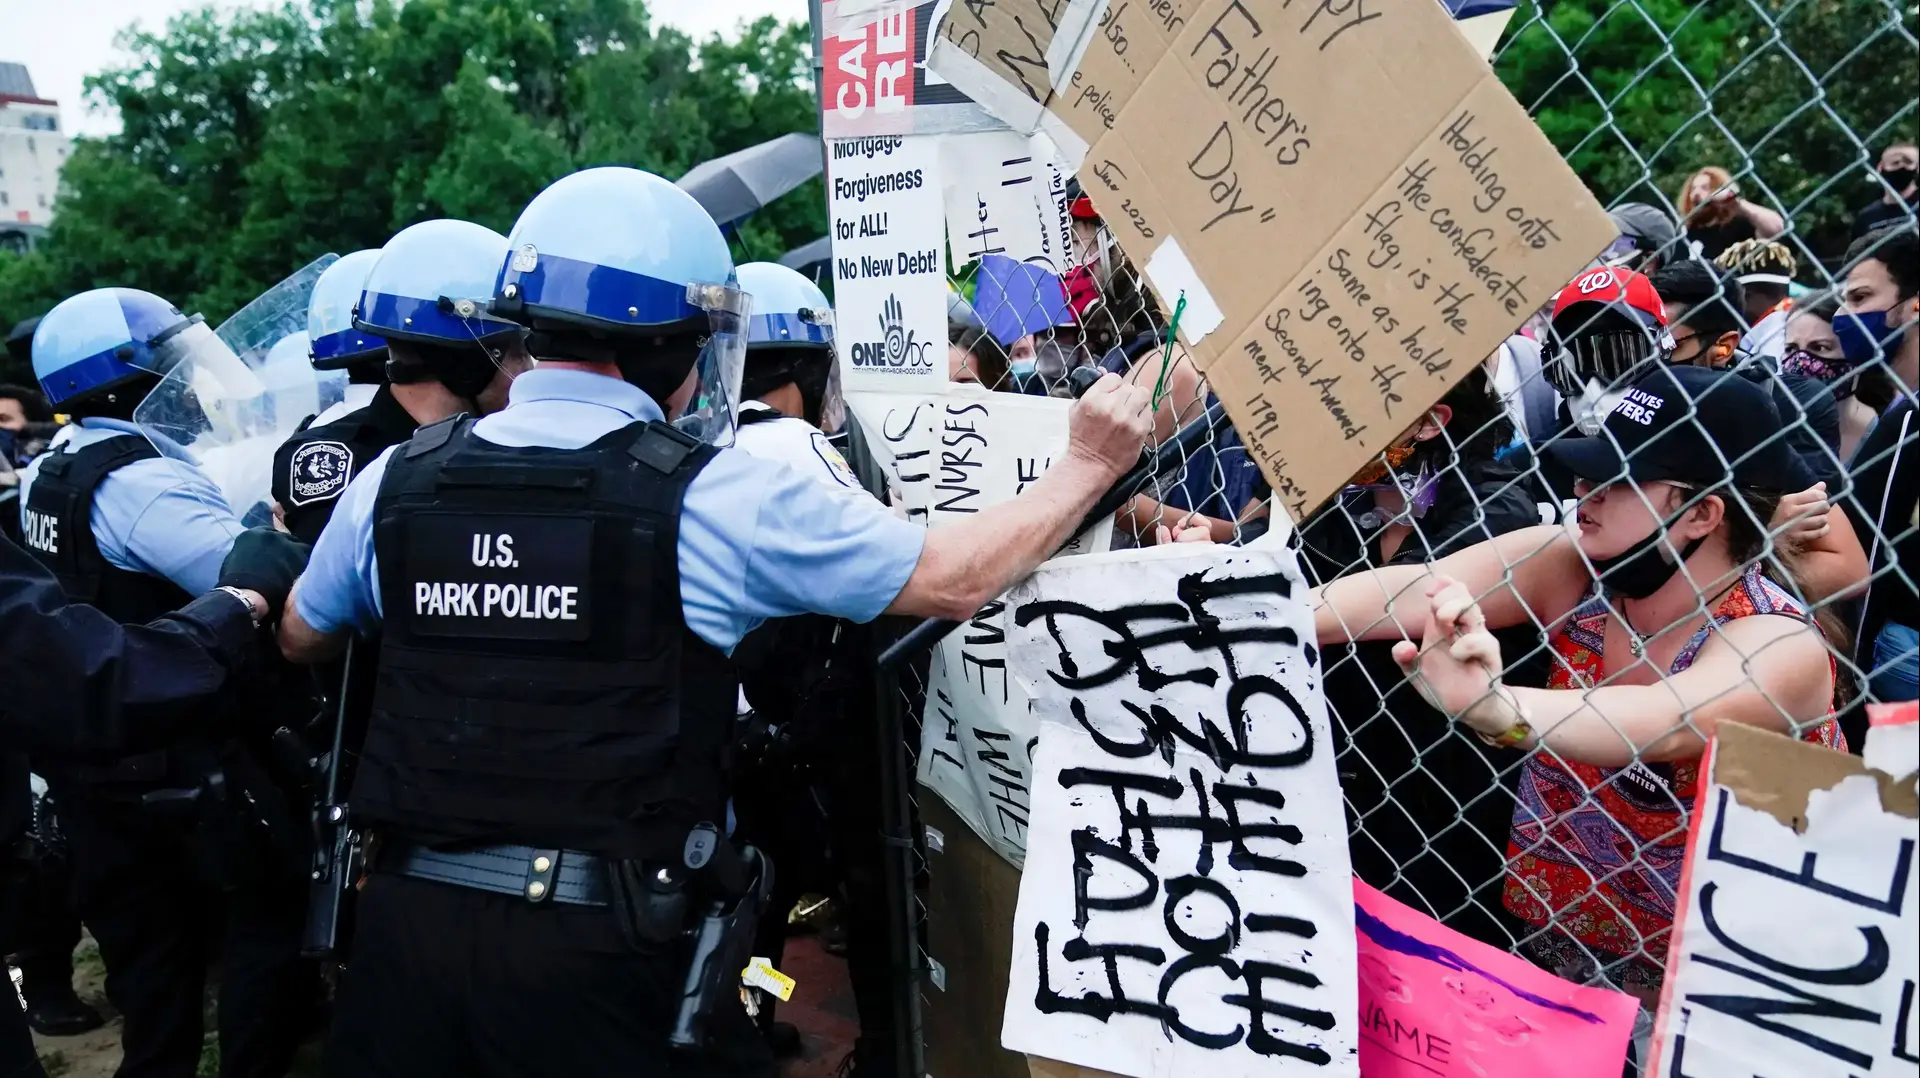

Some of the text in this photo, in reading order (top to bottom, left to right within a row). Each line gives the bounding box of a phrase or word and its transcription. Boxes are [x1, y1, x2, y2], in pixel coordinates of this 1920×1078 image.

[1191, 0, 1310, 165] Father's
[1073, 85, 1115, 131] police
[834, 134, 903, 160] Mortgage
[835, 168, 923, 202] Forgiveness
[1440, 110, 1561, 249] Holding onto
[836, 211, 888, 240] for ALL!
[968, 191, 1005, 258] Her
[1121, 199, 1155, 238] 2020
[1397, 159, 1528, 316] the confederate
[838, 248, 937, 280] No New Debt!
[1408, 257, 1431, 289] is
[1434, 282, 1475, 335] the
[1372, 306, 1399, 333] as
[851, 341, 933, 367] ONE DC
[1244, 340, 1286, 385] ment
[1298, 269, 1407, 419] ing onto the
[1246, 393, 1279, 439] 1791
[1631, 389, 1664, 409] LIVES
[935, 403, 988, 513] NURSES
[1247, 431, 1281, 463] repel
[472, 533, 519, 567] U.S.
[415, 582, 578, 620] PARK POLICE
[1622, 771, 1656, 793] MATTER
